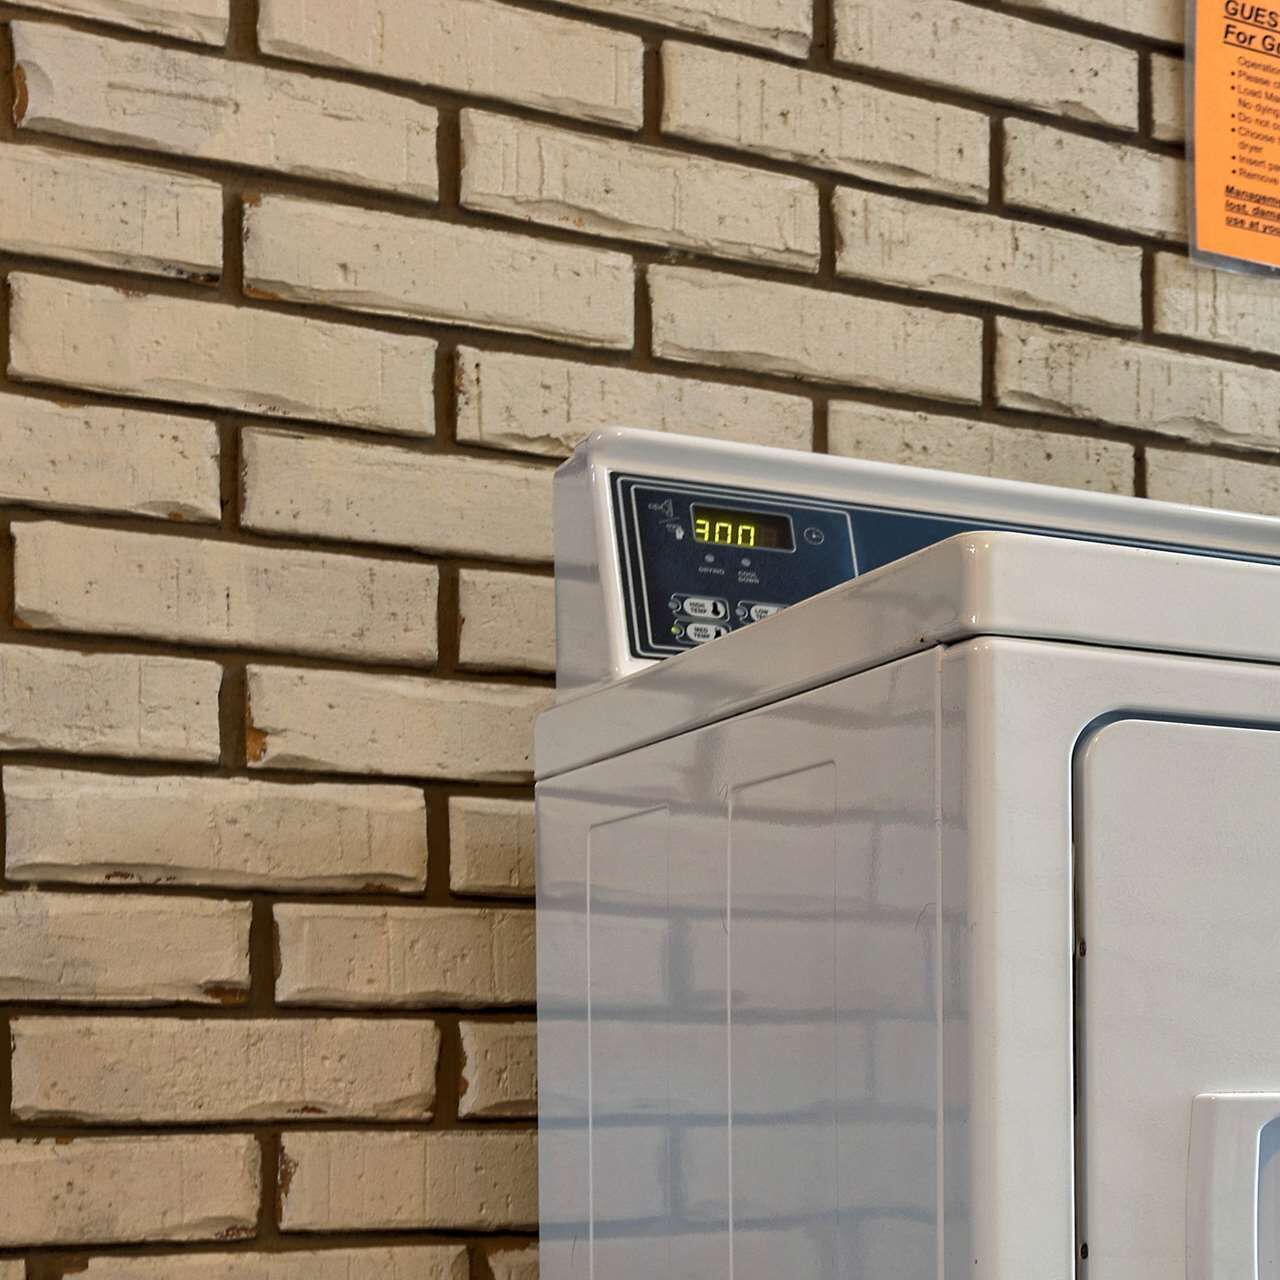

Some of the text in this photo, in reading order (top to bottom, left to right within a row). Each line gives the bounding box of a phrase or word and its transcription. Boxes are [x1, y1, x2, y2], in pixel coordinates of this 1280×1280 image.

[1224, 24, 1256, 45] For
[1238, 70, 1270, 86] Please
[1238, 84, 1262, 98] Load
[1238, 98, 1252, 109] No
[1238, 112, 1252, 123] Do
[1255, 118, 1270, 127] not
[1238, 126, 1275, 143] Choose
[1238, 141, 1263, 153] dryer
[1239, 155, 1266, 168] Insert
[1239, 168, 1279, 185] Remove
[1226, 216, 1246, 227] use
[1249, 220, 1259, 230] at
[696, 519, 755, 547] 300
